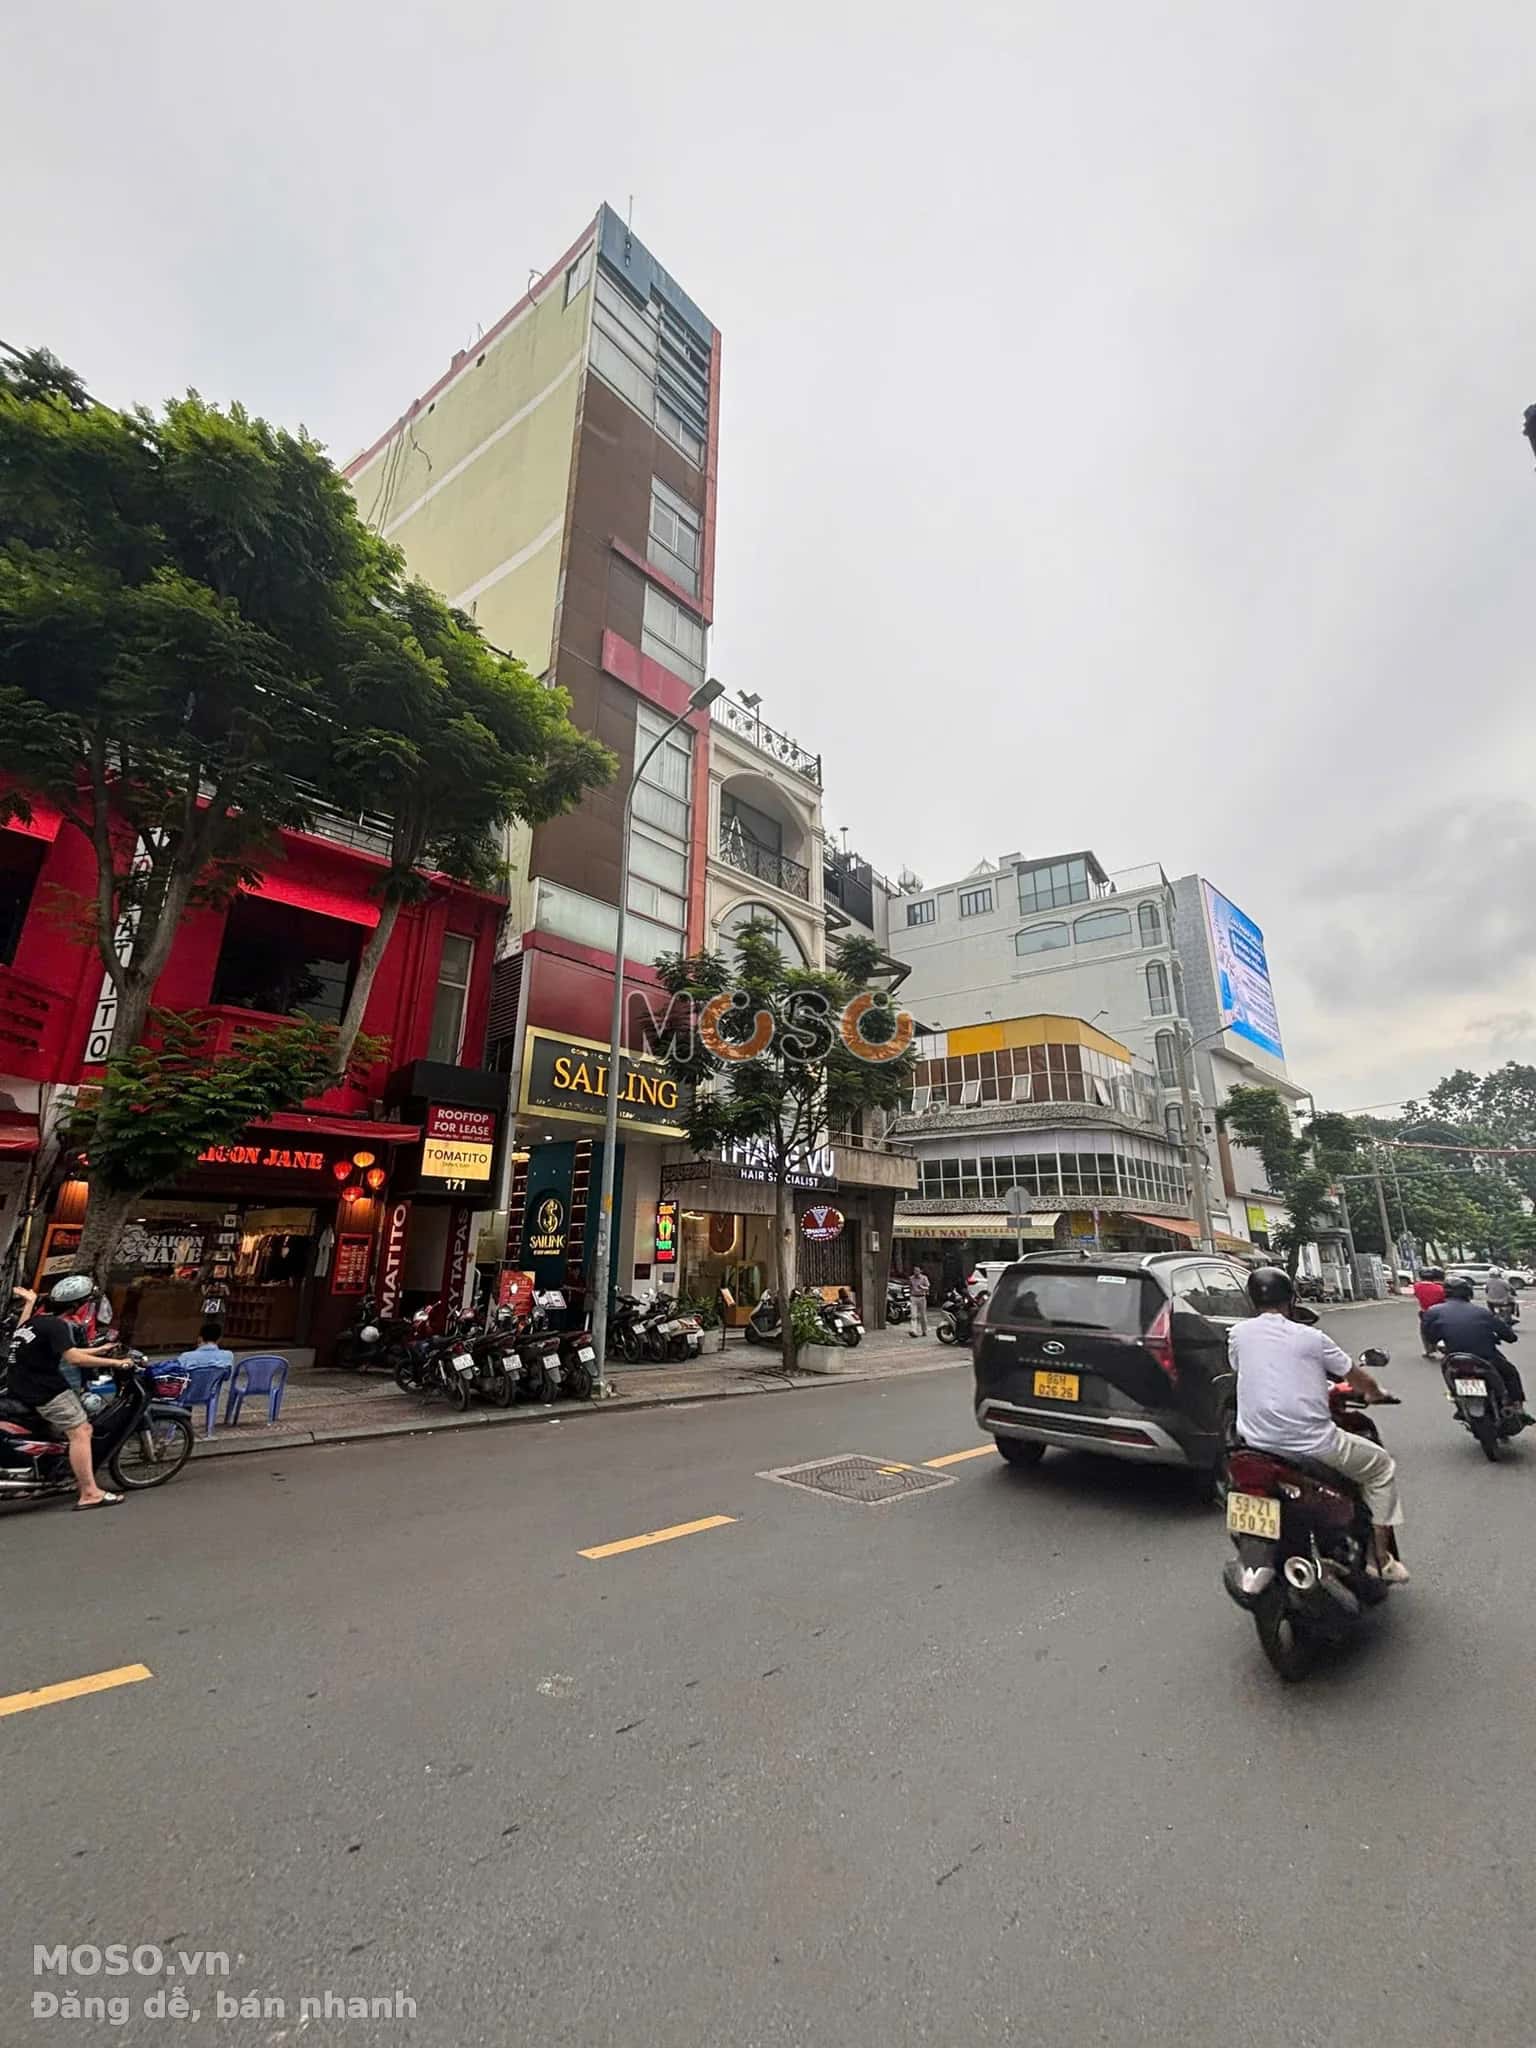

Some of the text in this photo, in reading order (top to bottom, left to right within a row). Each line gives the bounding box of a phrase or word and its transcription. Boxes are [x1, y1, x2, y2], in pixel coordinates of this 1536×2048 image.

[553, 1057, 679, 1109] SAIING
[437, 1109, 489, 1123] ROOFTOP
[434, 1121, 489, 1136] FOR LEASE
[263, 1148, 323, 1170] JANE
[427, 1149, 488, 1164] TOMATITO
[740, 1168, 765, 1181] HAIR
[445, 1179, 466, 1191] 171
[939, 1228, 968, 1238] NAM
[141, 1247, 202, 1263] JANE
